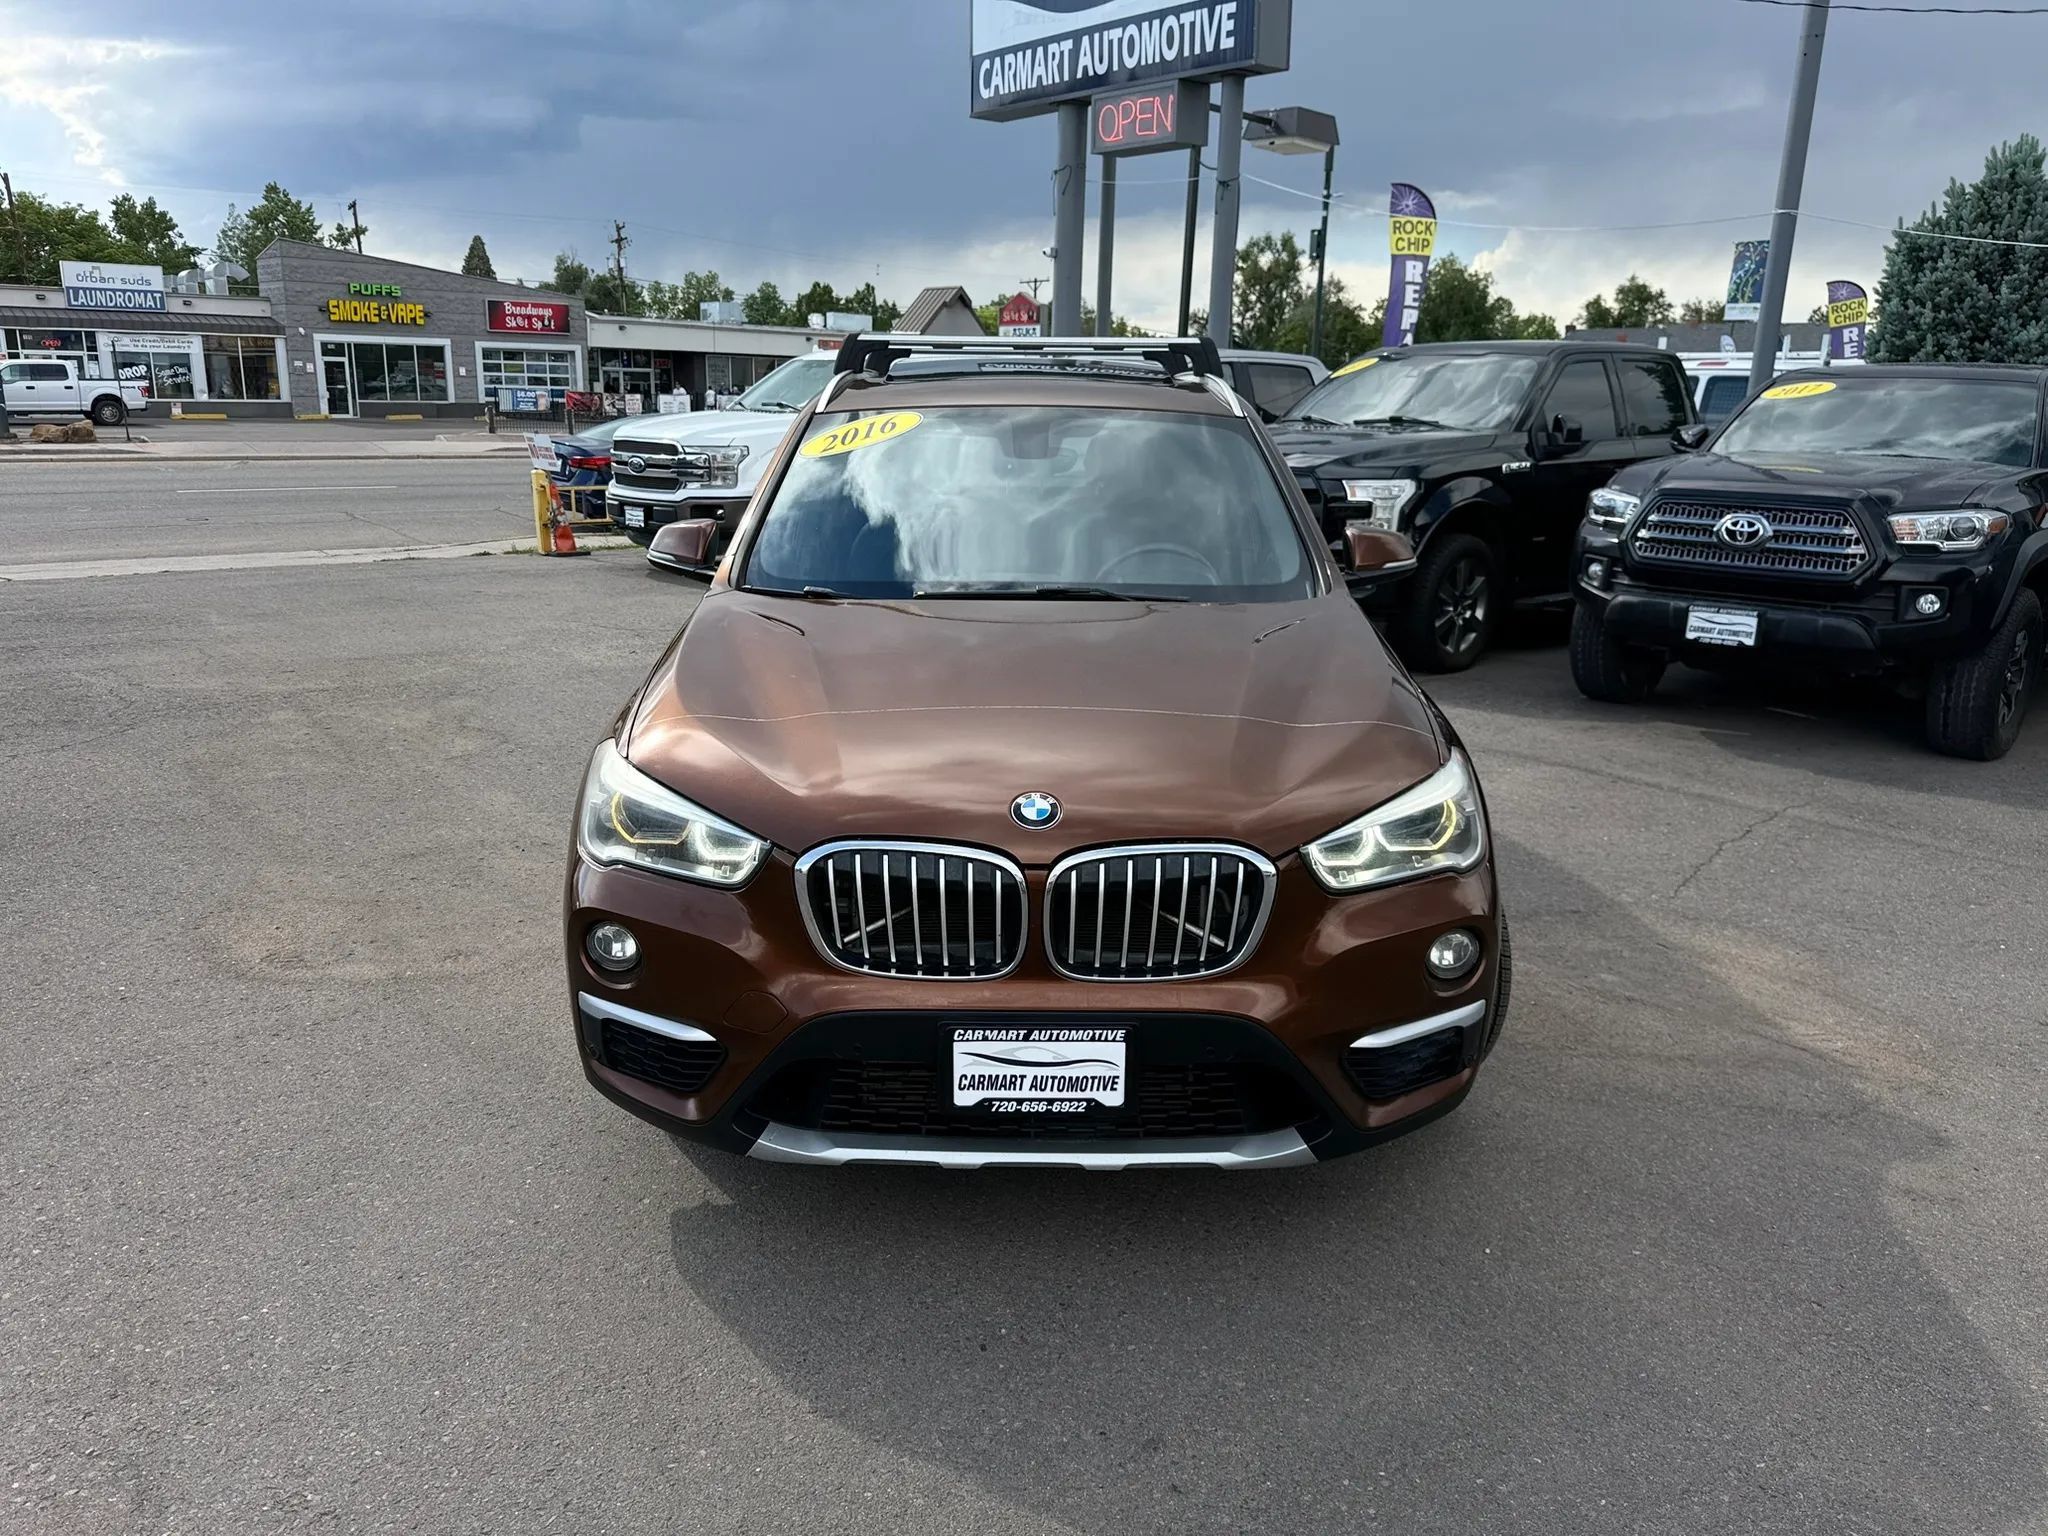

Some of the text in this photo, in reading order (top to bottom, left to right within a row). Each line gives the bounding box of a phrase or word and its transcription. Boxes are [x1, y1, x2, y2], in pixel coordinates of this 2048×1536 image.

[979, 1, 1237, 99] CARMART AUTOMOTIVE
[1099, 94, 1174, 142] OPEN
[1392, 220, 1433, 236] ROCK
[1395, 237, 1430, 253] CHIP
[120, 276, 152, 287] suds
[349, 283, 401, 296] PUFFS
[69, 289, 162, 309] LAUNDROMAT
[328, 299, 425, 325] SMOKE & VAPE
[1830, 299, 1866, 315] ROCK
[1833, 311, 1864, 325] CHIP
[40, 338, 61, 348] OPEN
[118, 365, 148, 380] DROP
[155, 367, 175, 378] Same
[1771, 383, 1823, 397] 2017
[820, 415, 900, 454] 2016
[953, 1029, 1126, 1041] CARMART AUTOMOTIVE
[958, 1073, 1120, 1092] CARMART AUTOMOTIVE
[991, 1101, 1087, 1112] 720-656-6922
